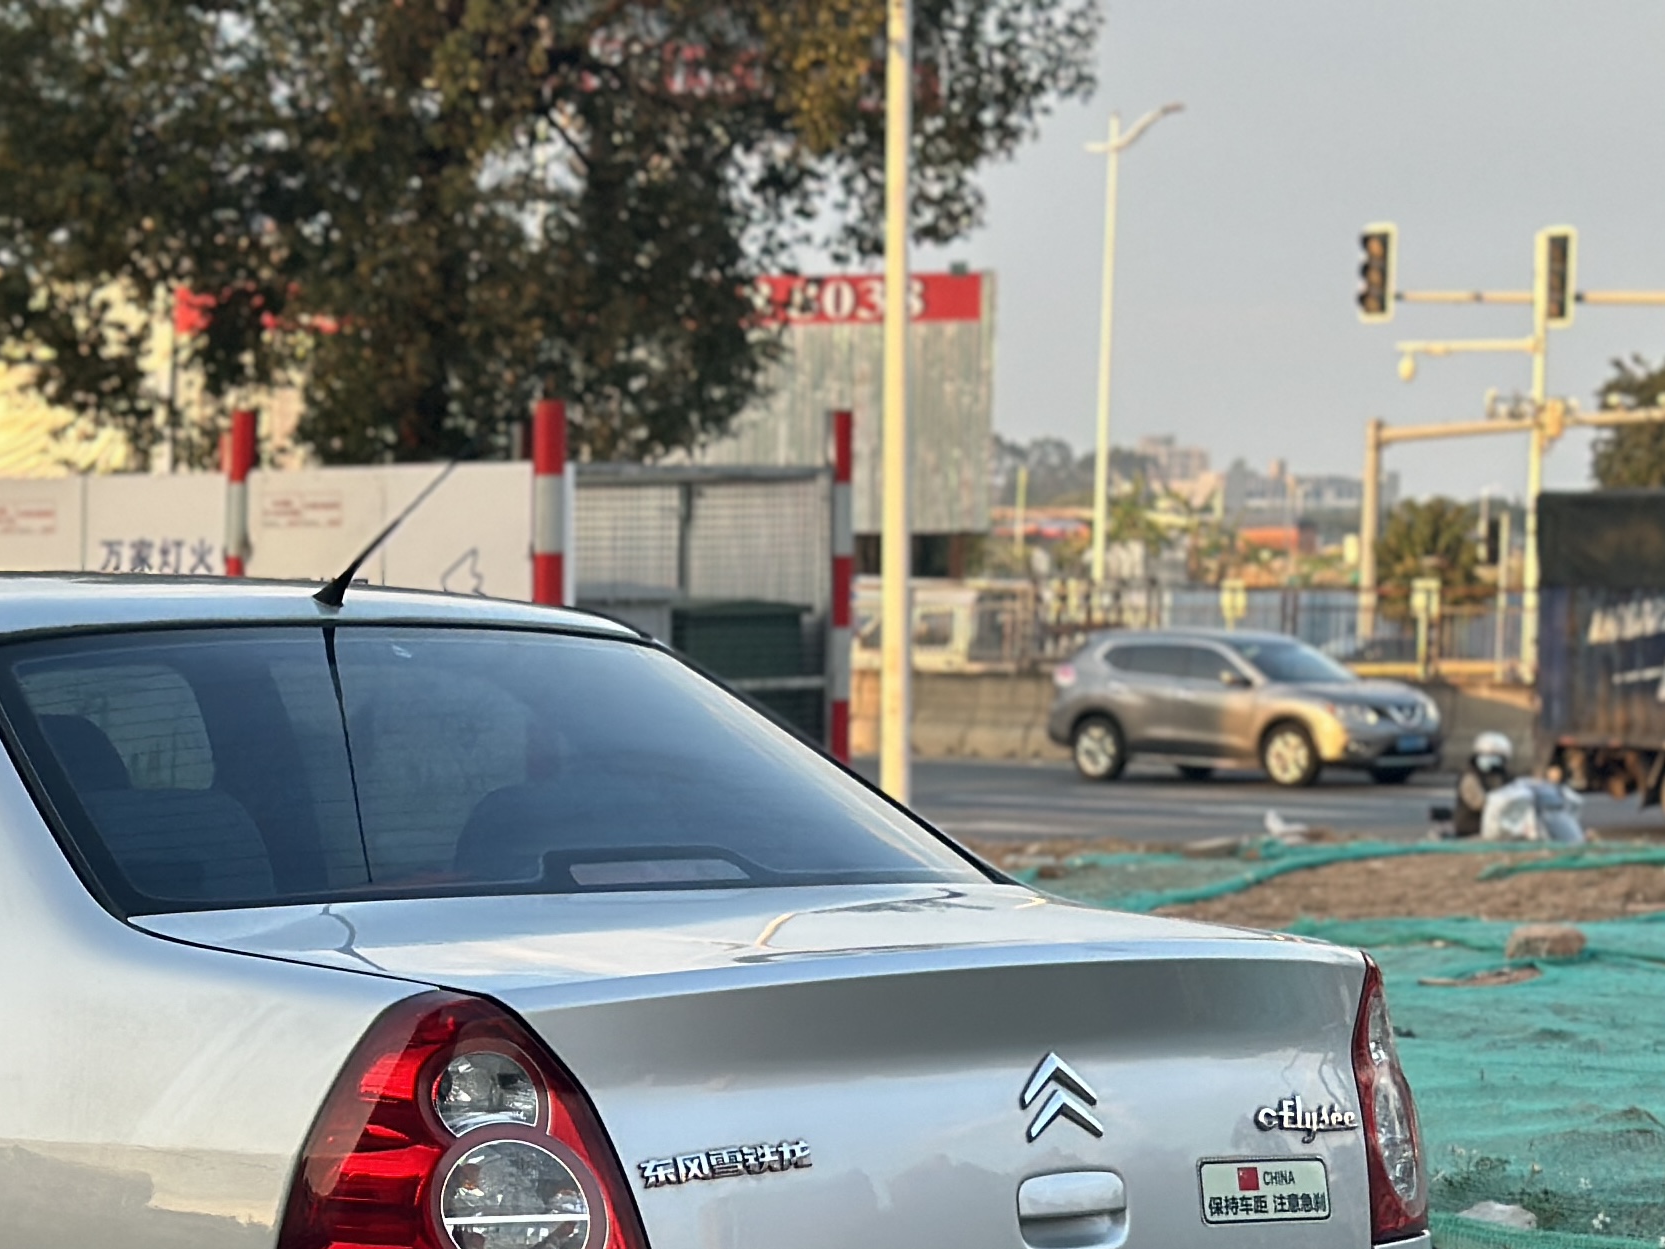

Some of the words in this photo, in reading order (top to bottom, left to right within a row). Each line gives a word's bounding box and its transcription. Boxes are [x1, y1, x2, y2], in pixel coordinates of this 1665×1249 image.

[100, 538, 215, 573] 万家灯火
[637, 1138, 813, 1188] 东风雪铁龙
[1262, 1170, 1296, 1186] CHINA
[1208, 1195, 1269, 1216] 保持车距
[1273, 1192, 1327, 1213] 注意急刹
